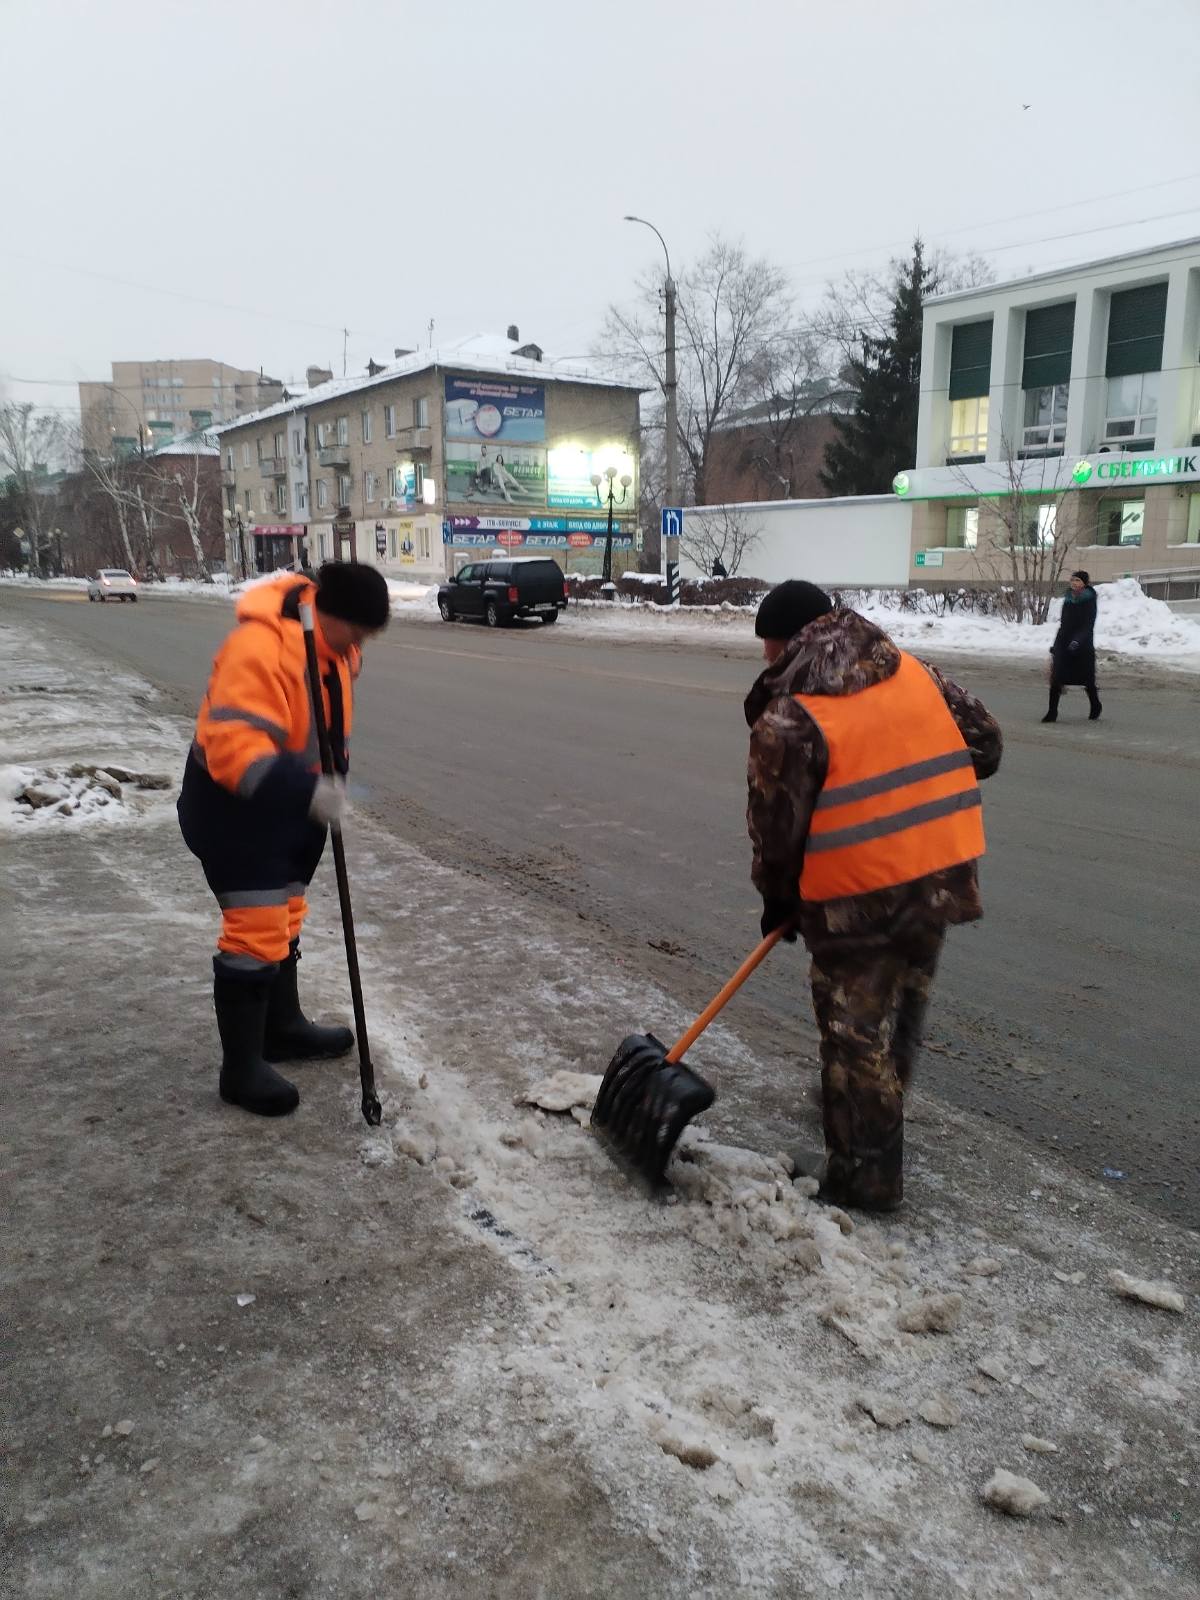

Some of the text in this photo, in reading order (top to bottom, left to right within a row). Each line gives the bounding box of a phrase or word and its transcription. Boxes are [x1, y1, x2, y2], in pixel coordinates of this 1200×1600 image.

[503, 406, 543, 417] БЕТАР
[1097, 456, 1197, 479] СБЕРБАНК
[542, 521, 559, 529] ЭТАЖ
[568, 521, 583, 530] ВХОД
[583, 521, 591, 529] СО
[453, 534, 496, 545] БЕТАР
[526, 535, 567, 545] БЕТАР
